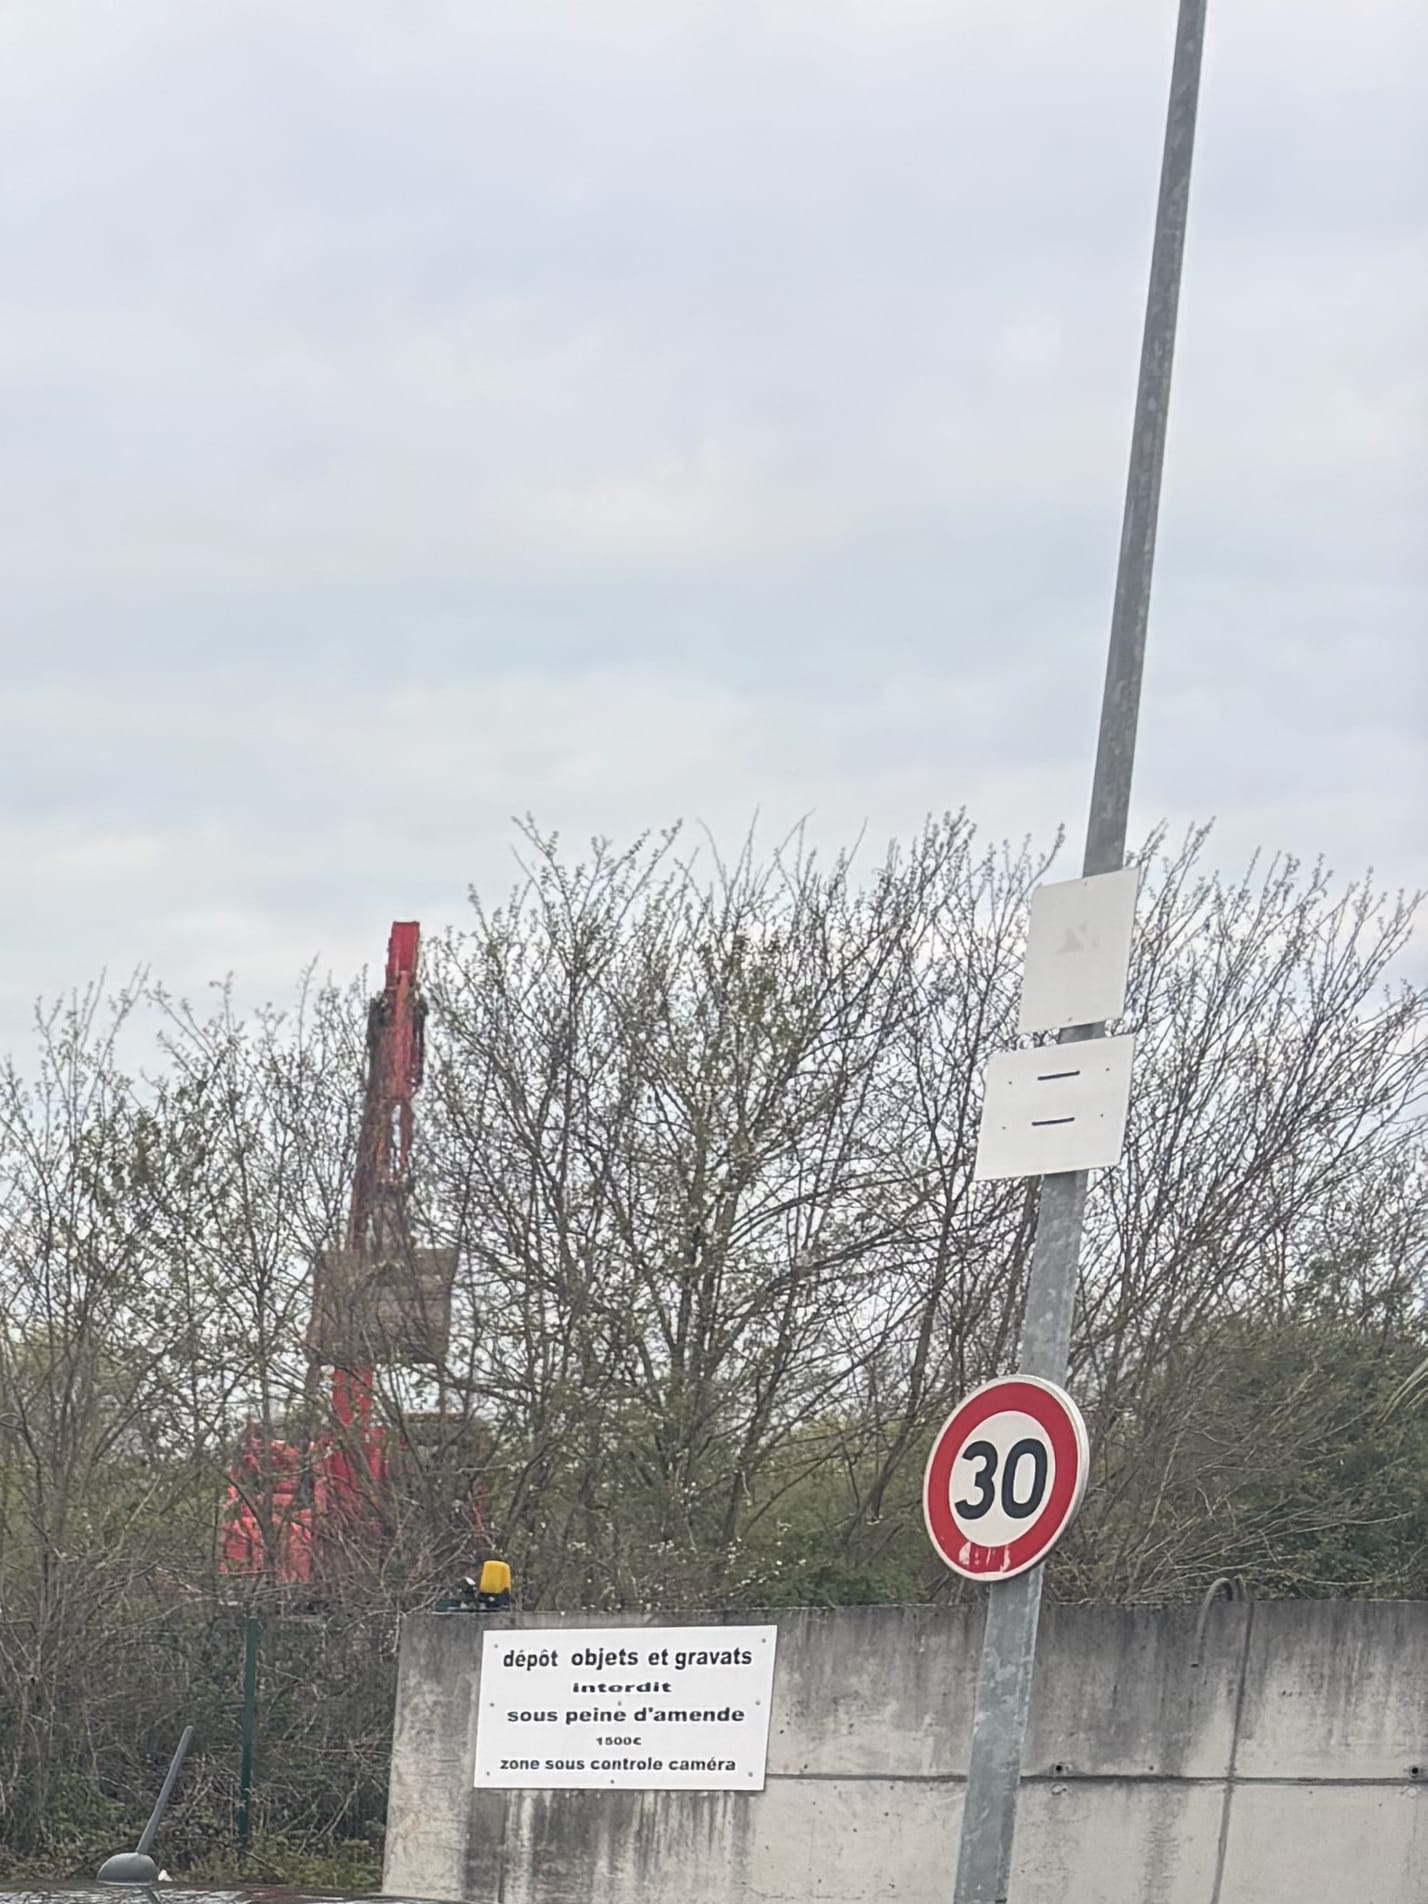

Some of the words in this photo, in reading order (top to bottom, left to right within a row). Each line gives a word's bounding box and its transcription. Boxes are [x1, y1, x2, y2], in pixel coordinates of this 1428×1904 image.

[955, 1438, 1048, 1520] 30
[503, 1649, 559, 1672] dépôt
[570, 1648, 639, 1671] objets
[648, 1647, 669, 1666] et
[675, 1646, 753, 1670] gravats
[572, 1681, 672, 1693] interdit
[507, 1709, 558, 1723] sous
[565, 1707, 627, 1725] peine
[634, 1706, 745, 1722] d'amende
[500, 1758, 540, 1771] zone
[545, 1758, 585, 1771] sous
[590, 1757, 663, 1771] controle
[668, 1756, 737, 1771] caméra
